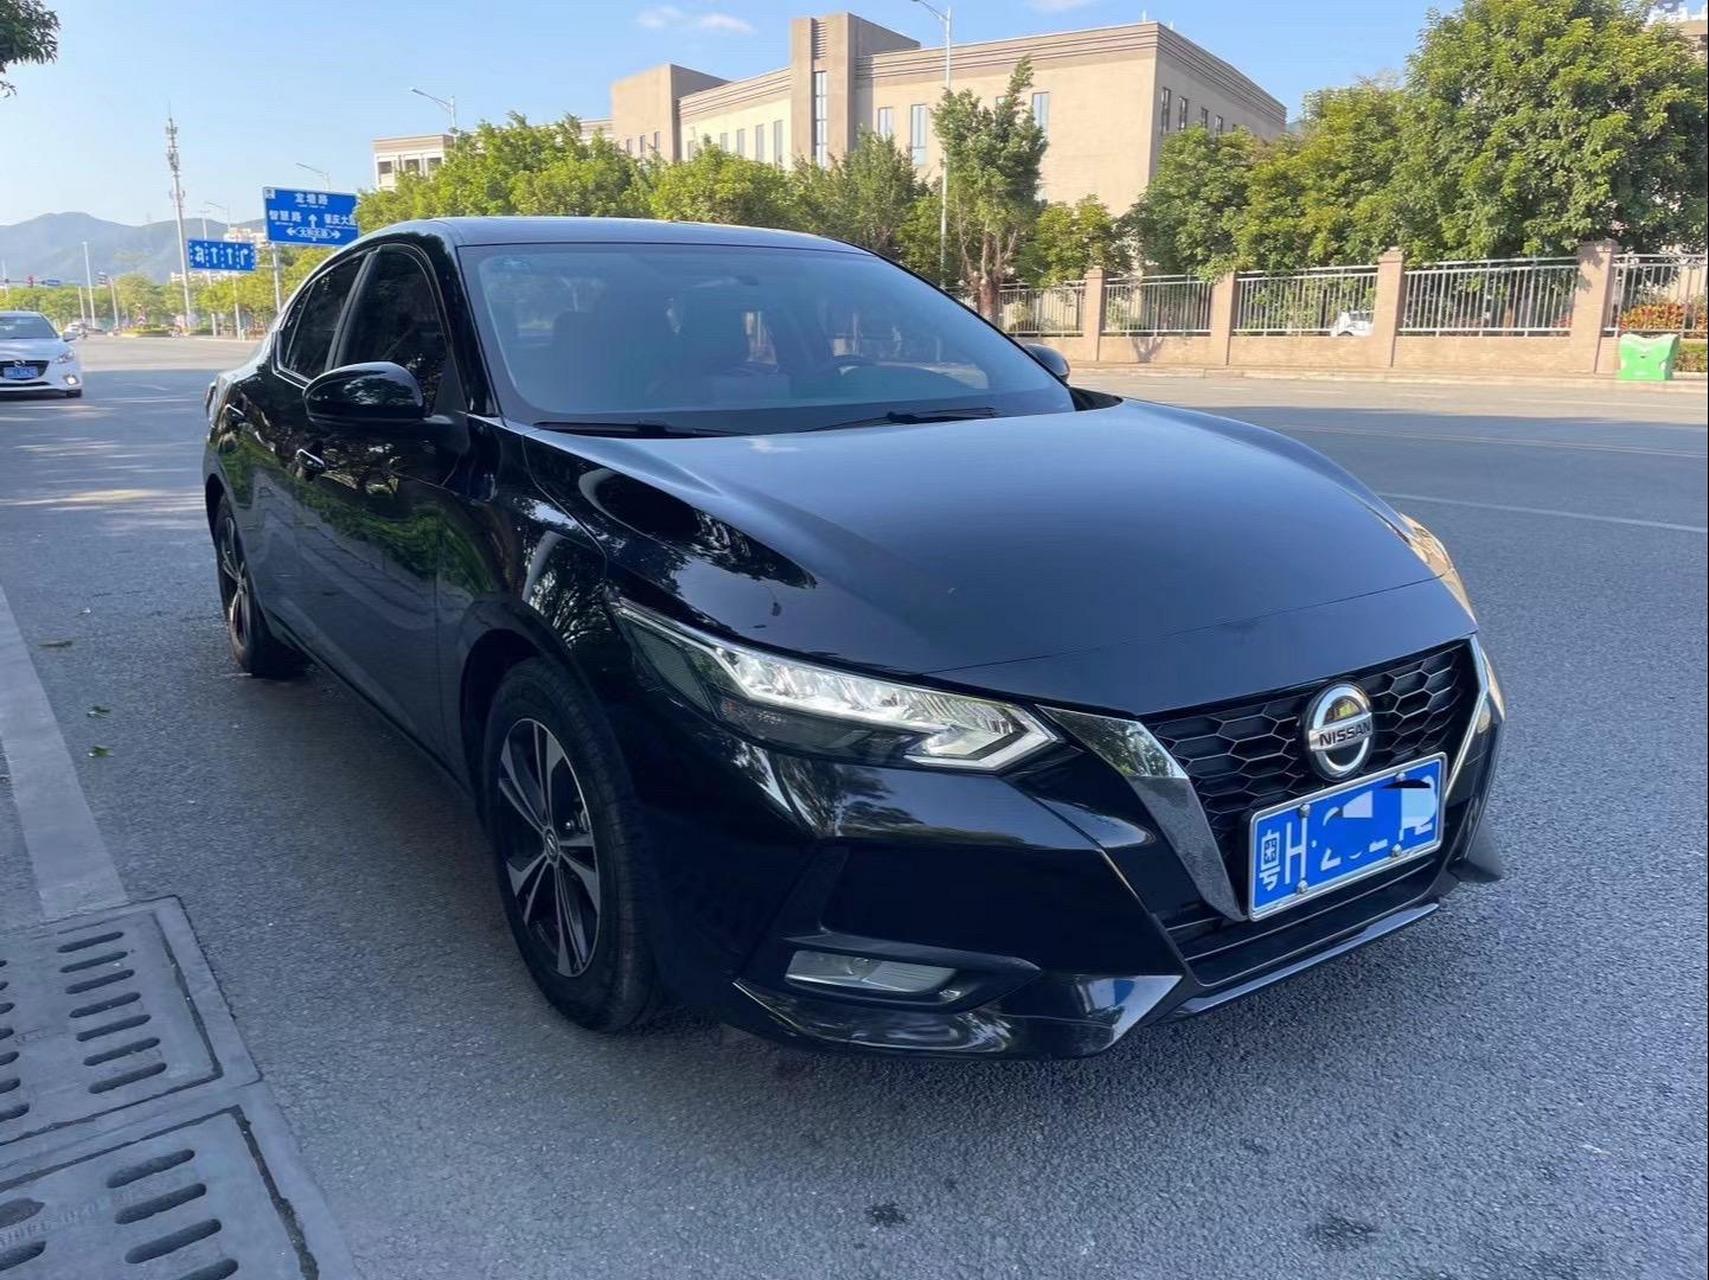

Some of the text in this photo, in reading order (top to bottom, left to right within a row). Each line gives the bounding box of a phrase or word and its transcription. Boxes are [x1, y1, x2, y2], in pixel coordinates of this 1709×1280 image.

[269, 210, 301, 222] 智慧路
[1319, 720, 1371, 747] NISSAN
